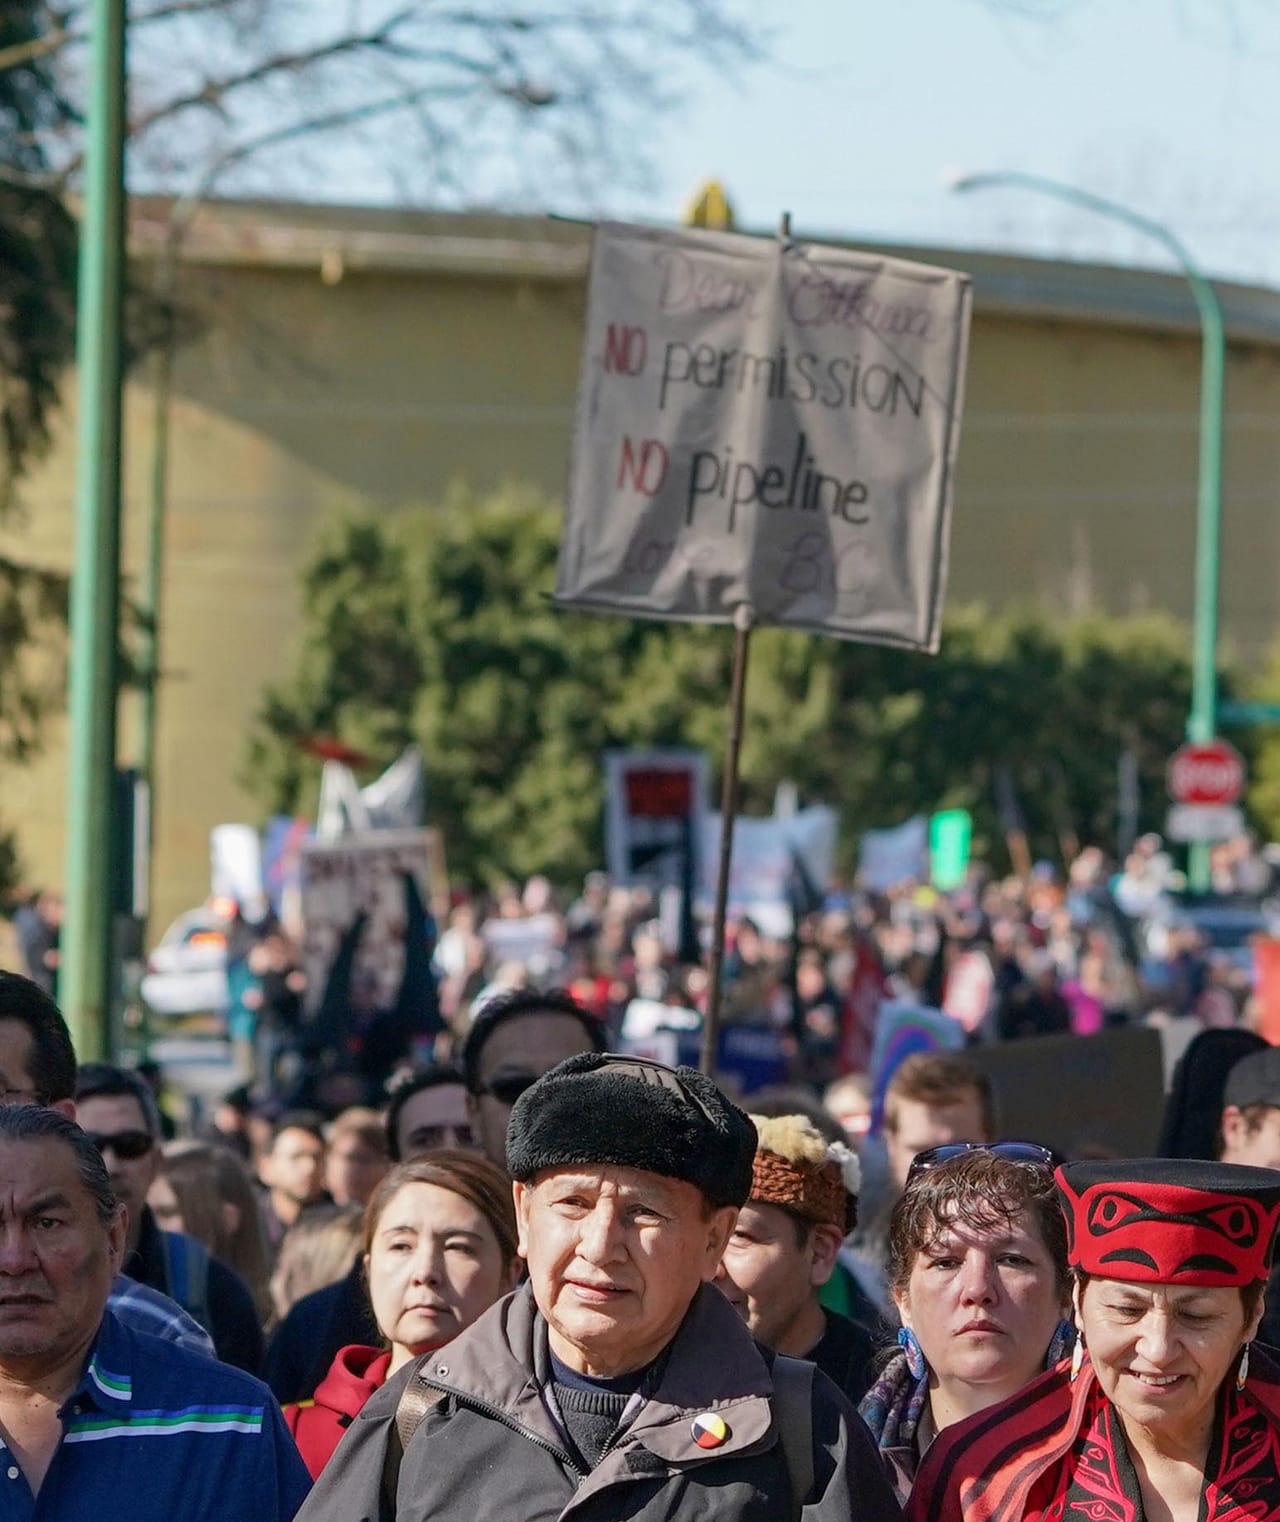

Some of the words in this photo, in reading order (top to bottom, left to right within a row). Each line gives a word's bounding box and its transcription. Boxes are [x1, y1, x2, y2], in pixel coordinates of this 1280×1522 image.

[604, 322, 647, 376] NO
[617, 434, 669, 497] NO
[686, 431, 870, 533] pipeline
